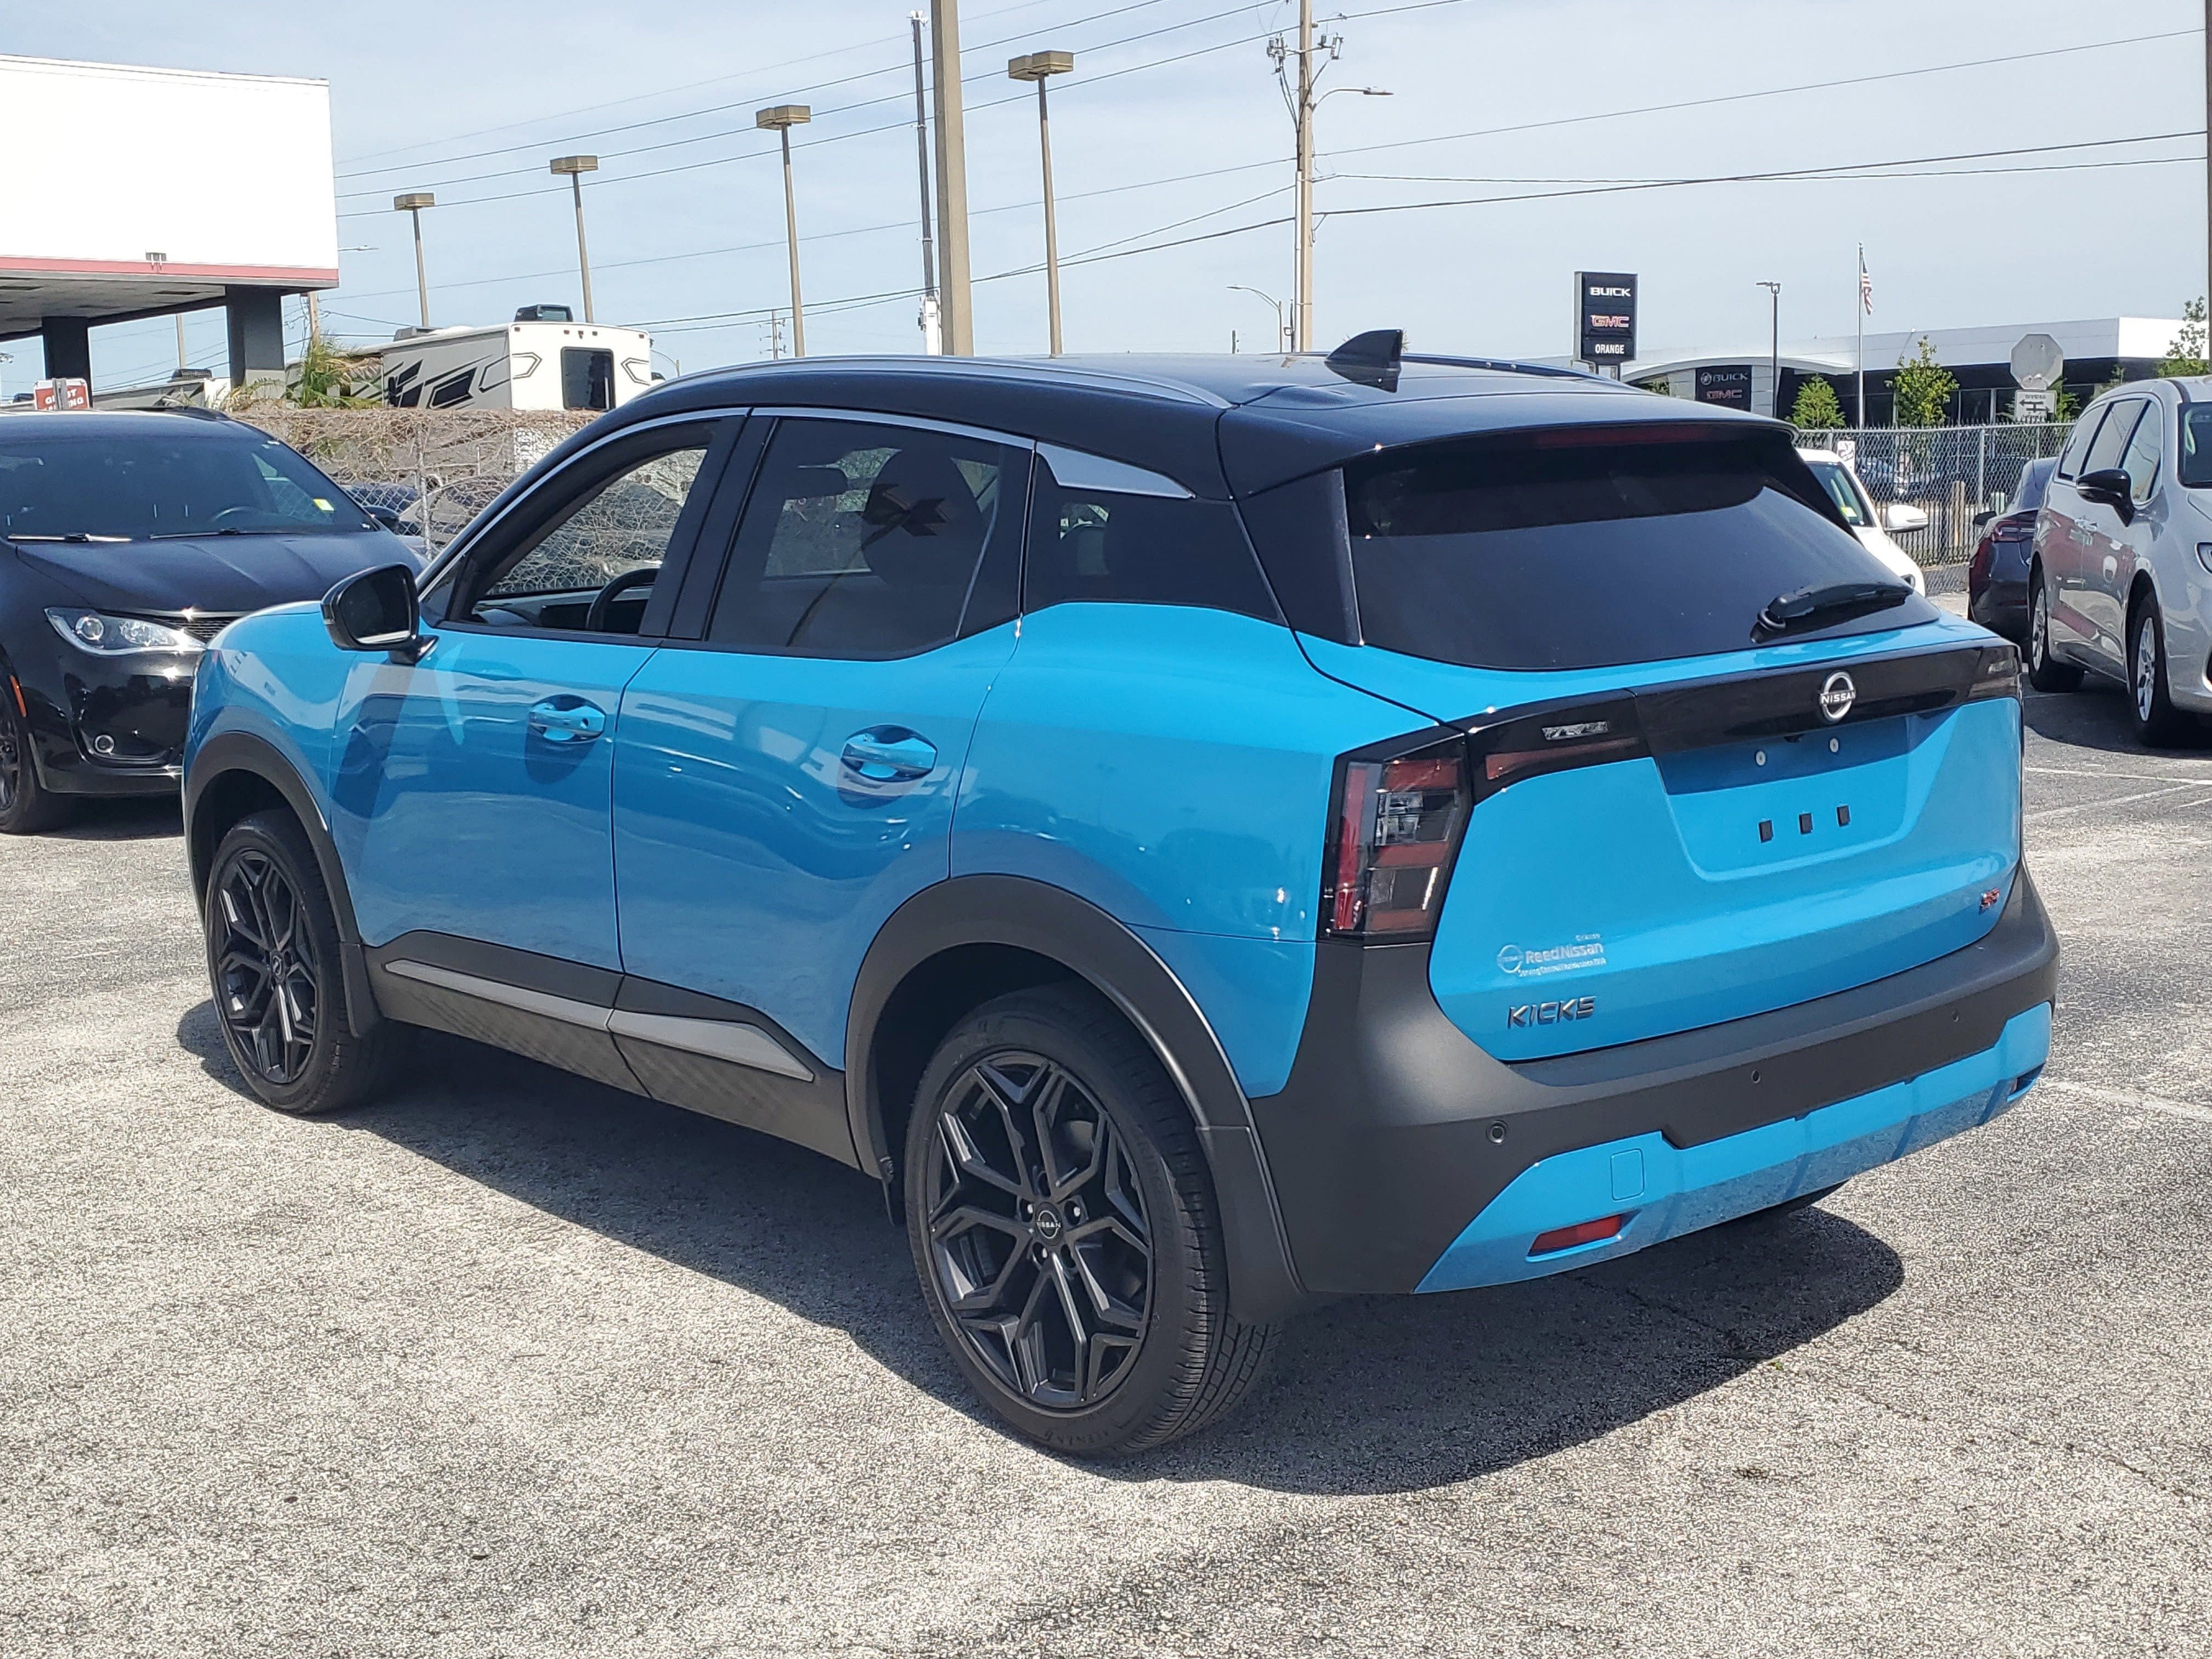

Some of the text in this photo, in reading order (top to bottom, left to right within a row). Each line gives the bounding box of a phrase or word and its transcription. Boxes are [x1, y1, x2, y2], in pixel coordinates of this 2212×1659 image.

[1590, 287, 1631, 297] BUICK
[1590, 315, 1629, 328] GMC
[1595, 343, 1624, 354] ORANGE
[1713, 373, 1748, 382] BUICK
[1707, 389, 1742, 399] GMC
[1821, 692, 1855, 704] NISSAN
[1508, 996, 1597, 1029] KICKS
